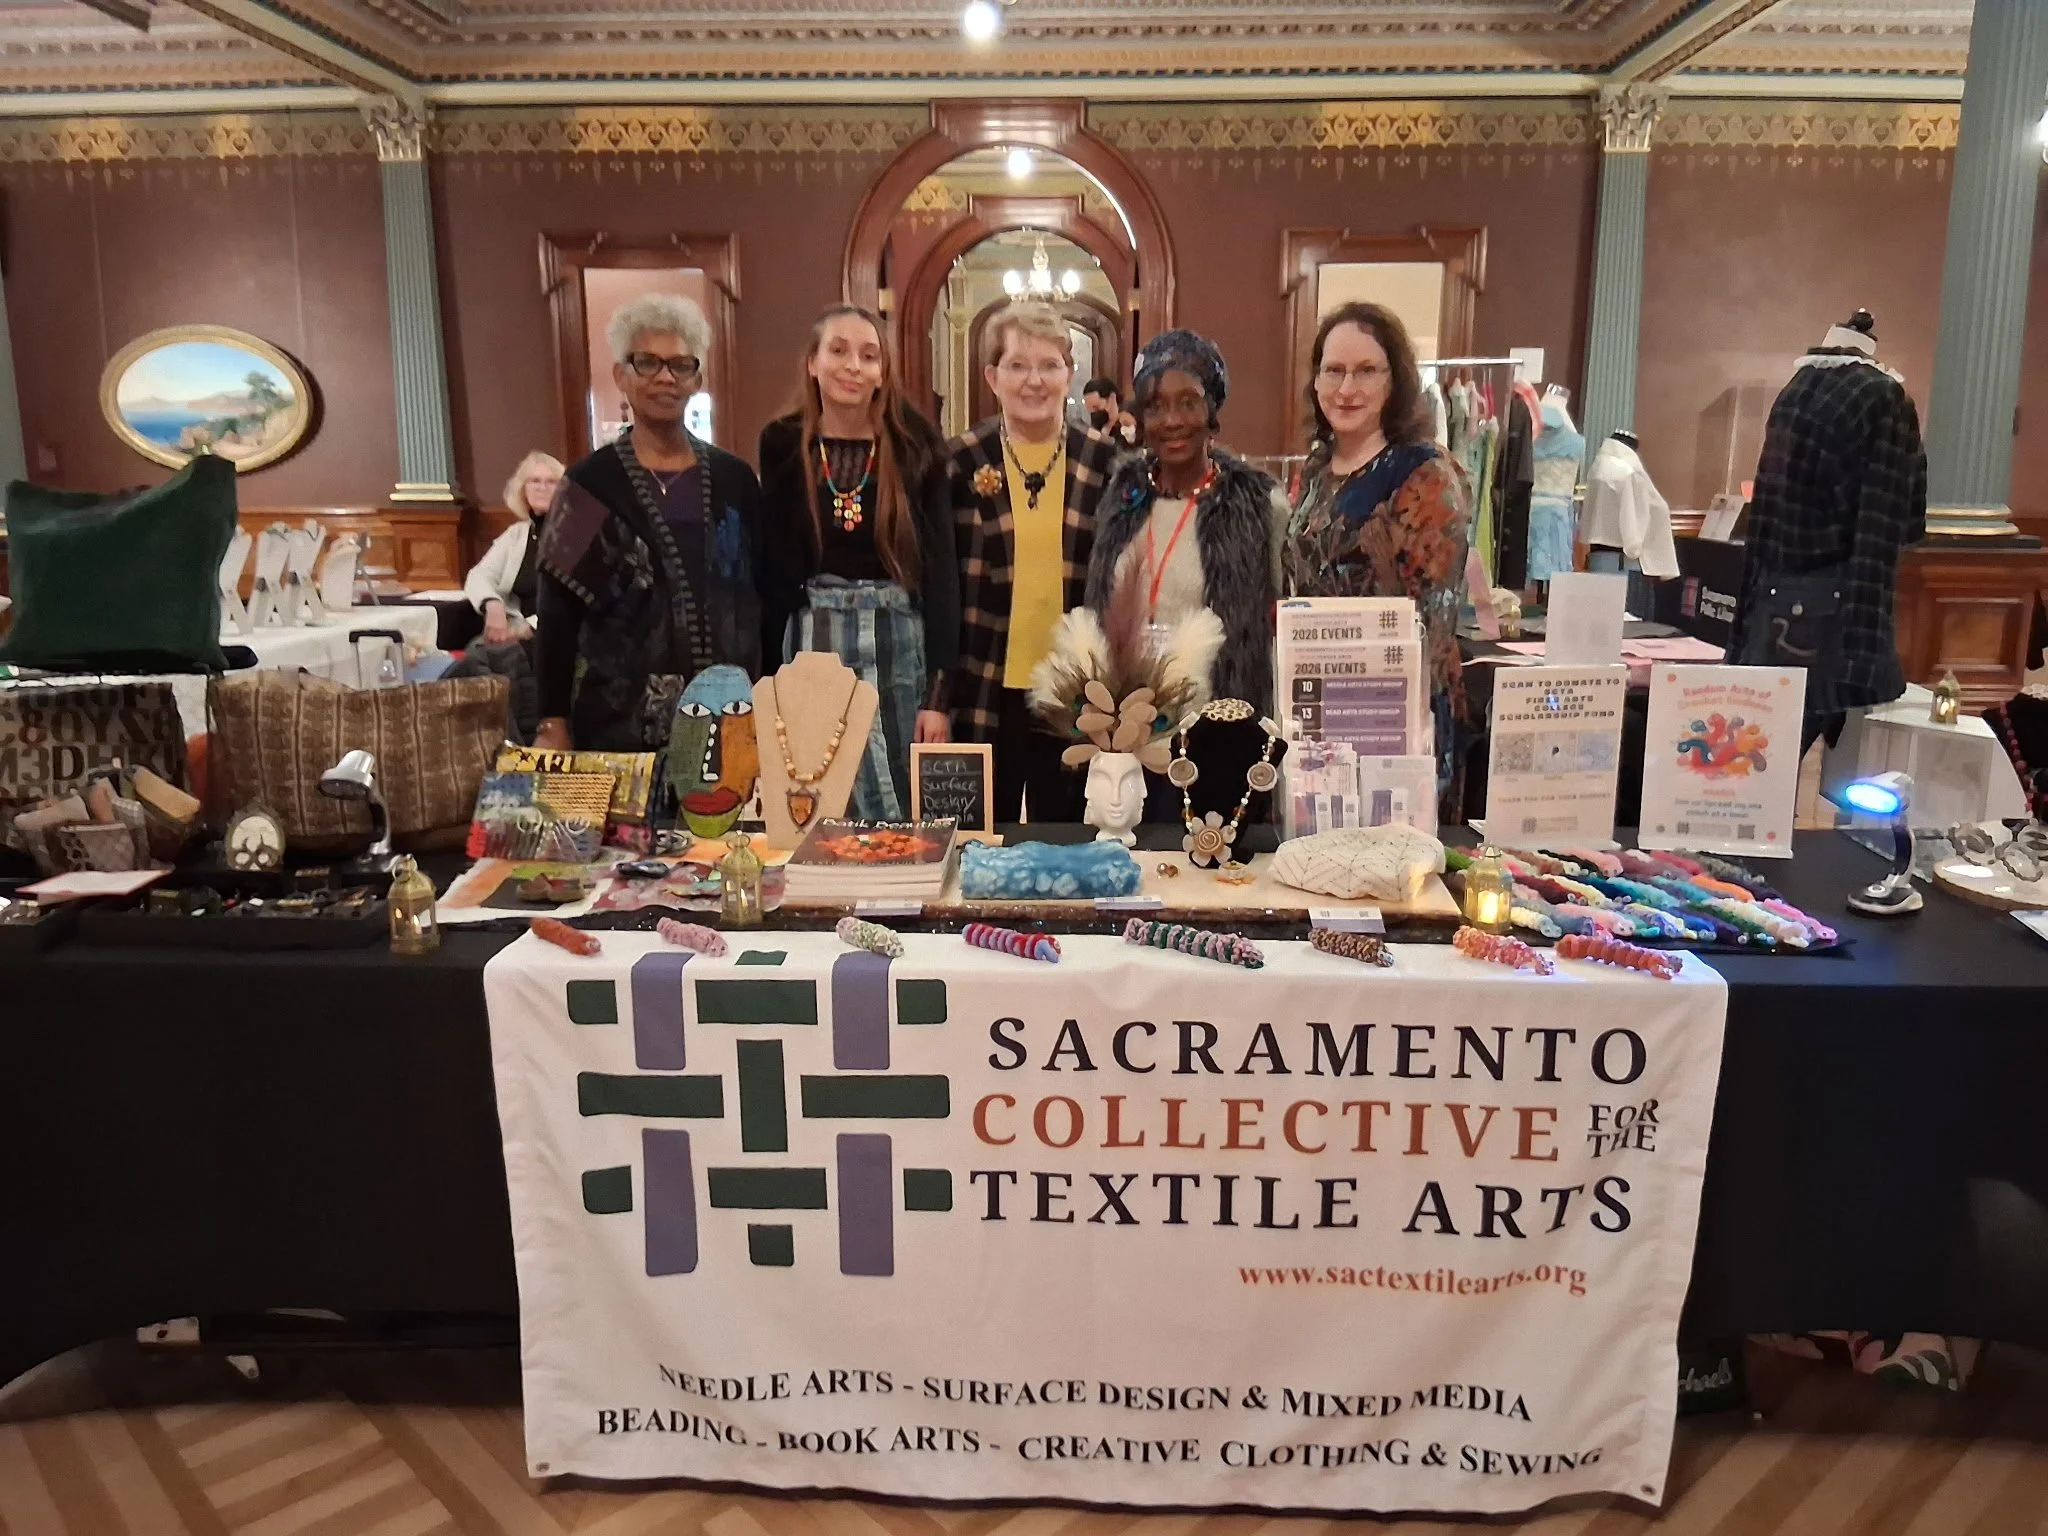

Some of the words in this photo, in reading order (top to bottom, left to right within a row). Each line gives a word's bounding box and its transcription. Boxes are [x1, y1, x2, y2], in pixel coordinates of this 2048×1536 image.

[1321, 627, 1362, 640] EVENTS
[1325, 662, 1367, 675] EVENTS
[1501, 681, 1533, 689] SCAN
[1302, 681, 1312, 692] 10
[1302, 708, 1312, 719] 13
[923, 777, 978, 793] Surface
[988, 1017, 1647, 1085] SACRAMENTO
[972, 1093, 1559, 1162] COLLECTIVE
[1588, 1098, 1660, 1132] FOR
[1586, 1124, 1657, 1158] THE
[970, 1170, 1358, 1229] TEXTILE
[1401, 1175, 1632, 1239] ARTS
[1241, 1264, 1588, 1297] www.sactextilearts.org
[658, 1364, 791, 1401] NEEDLE
[802, 1369, 895, 1396] ARTS
[923, 1376, 1087, 1405] SURFACE
[1097, 1381, 1232, 1410] DESIGN
[1241, 1385, 1269, 1410] &
[1281, 1387, 1402, 1418] MIXED
[1409, 1384, 1533, 1422] MEDIA
[598, 1407, 748, 1446] BEADING
[778, 1427, 880, 1454] BOOK
[889, 1425, 981, 1453] ARTS
[1018, 1437, 1200, 1464] CREATIVE
[1219, 1438, 1411, 1468] CLOTHING
[1421, 1442, 1448, 1466] &
[1459, 1444, 1605, 1477] SEWING
